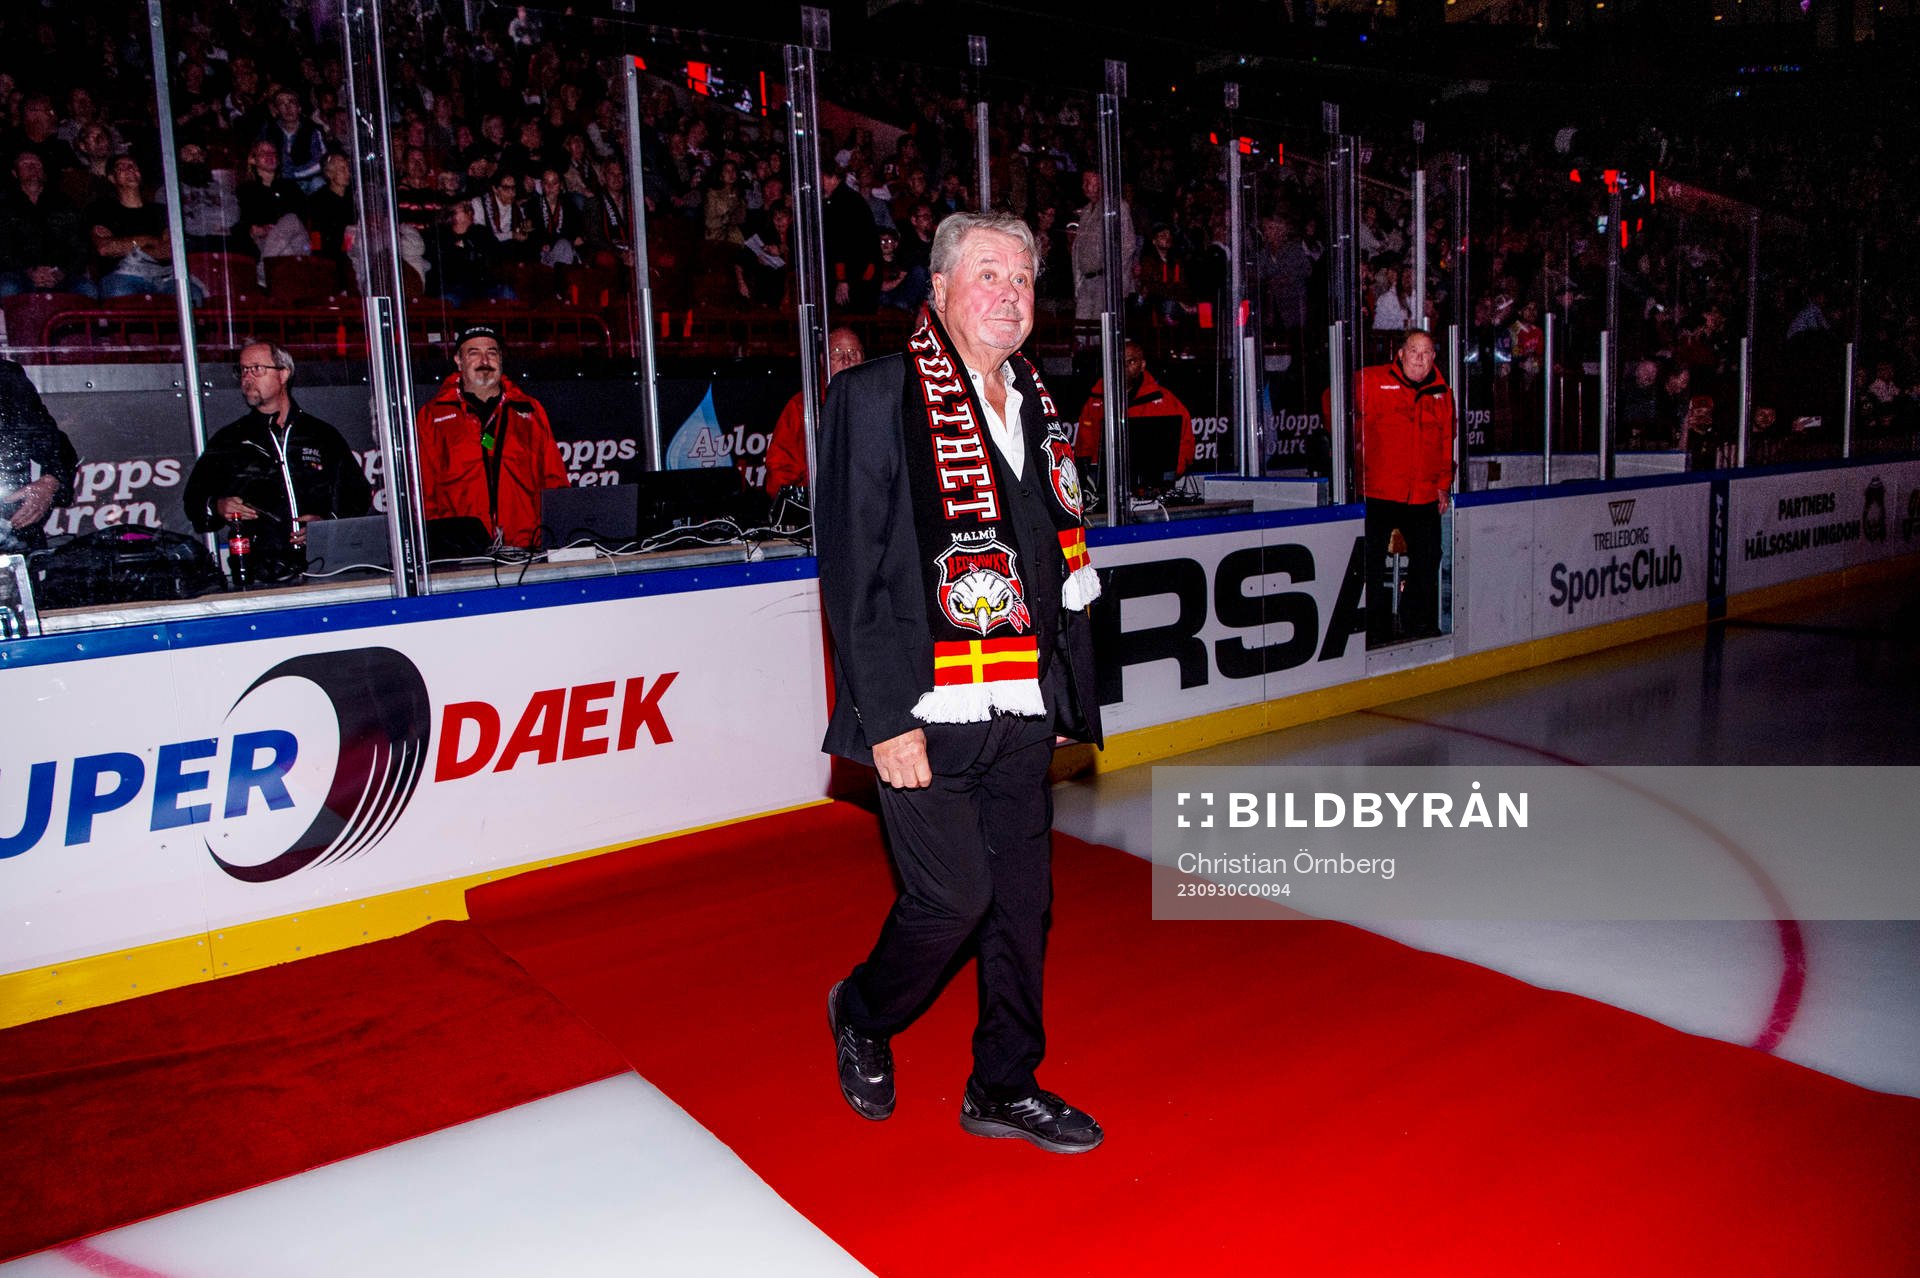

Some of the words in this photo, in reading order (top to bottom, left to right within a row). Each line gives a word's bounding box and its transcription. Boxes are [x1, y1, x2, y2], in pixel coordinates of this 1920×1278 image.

[907, 315, 1000, 521] TOLTHET
[1778, 492, 1835, 521] PARTNERS
[950, 526, 997, 542] MALMÖ
[1593, 526, 1649, 551] TRELLEBORG
[946, 553, 1009, 580] REDHAWKS
[1549, 544, 1682, 614] SportsClub
